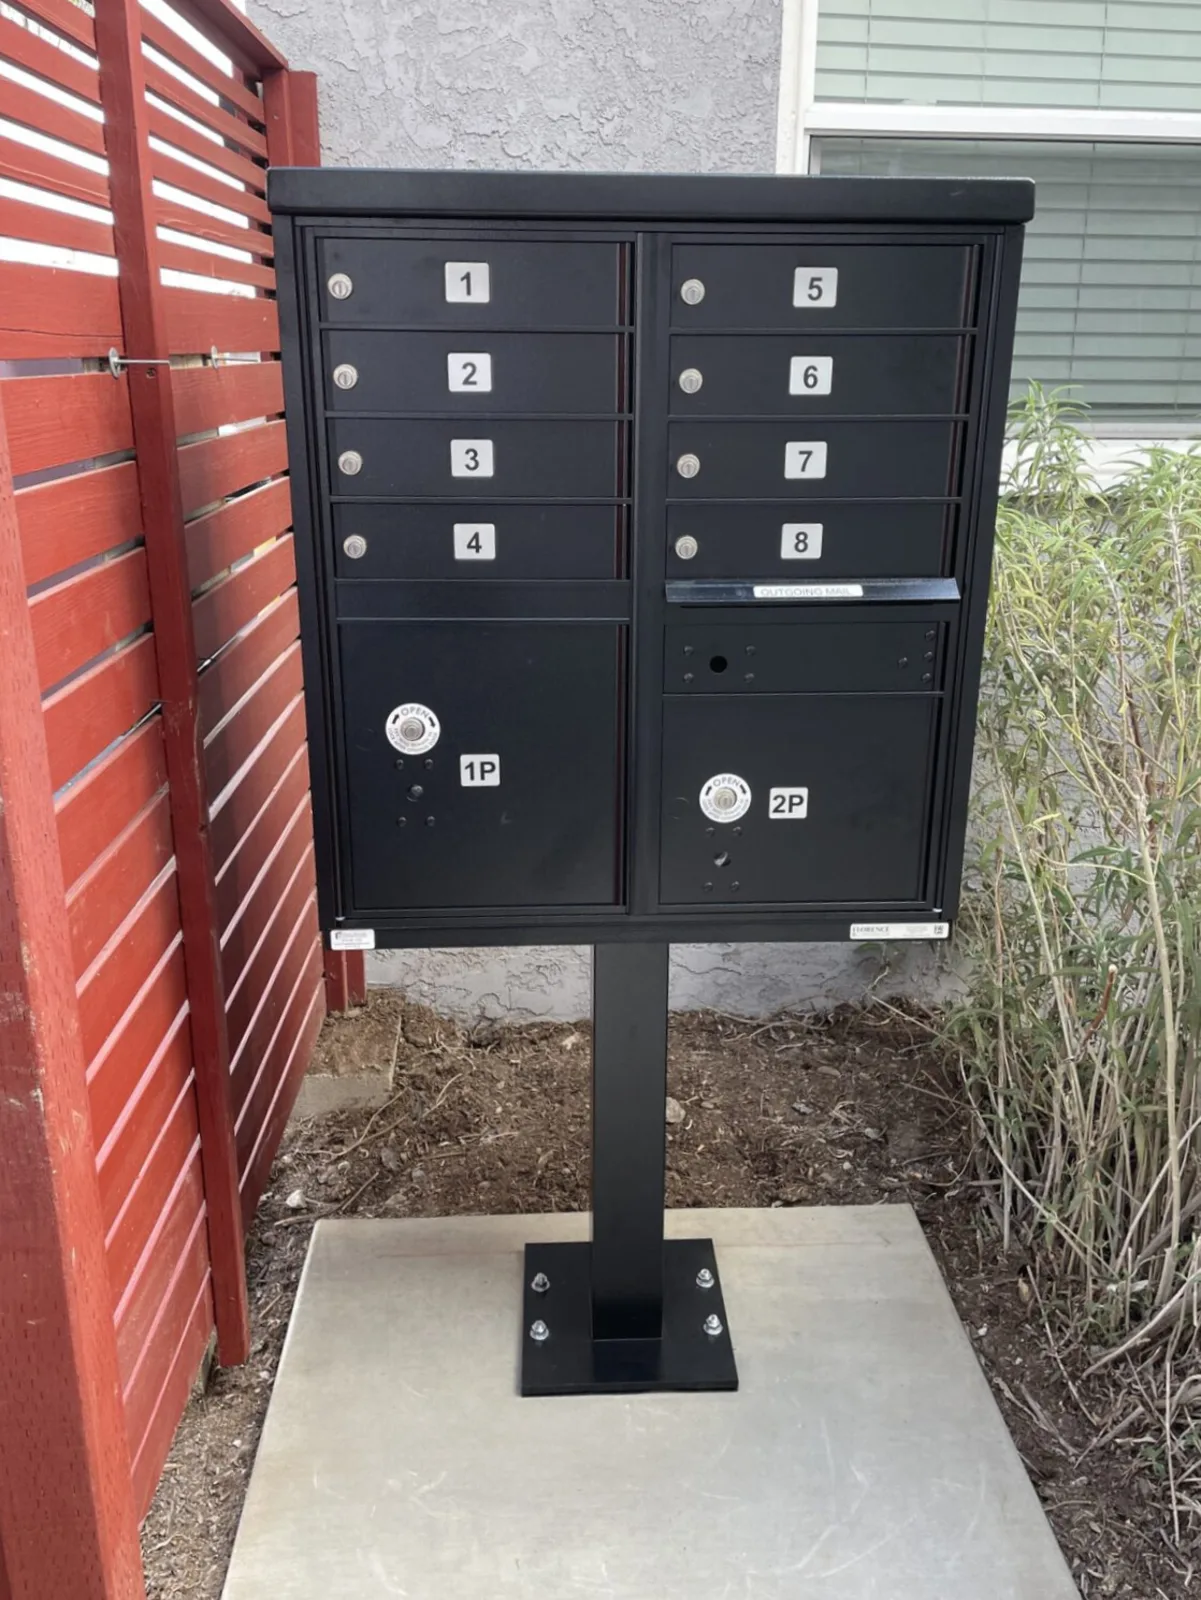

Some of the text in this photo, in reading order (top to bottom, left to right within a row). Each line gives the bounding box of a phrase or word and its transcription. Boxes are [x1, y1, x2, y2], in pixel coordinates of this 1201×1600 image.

[460, 271, 471, 296] 1
[807, 276, 822, 300] 5
[462, 362, 477, 385] 2
[803, 365, 818, 388] 6
[465, 448, 479, 471] 3
[798, 450, 813, 472] 7
[466, 531, 482, 554] 4
[794, 531, 808, 553] 8
[761, 587, 850, 596] OUTGOING MAIL
[400, 706, 430, 718] OPEN
[464, 761, 496, 781] 1P
[713, 776, 741, 788] OPEN
[772, 794, 804, 813] 2P
